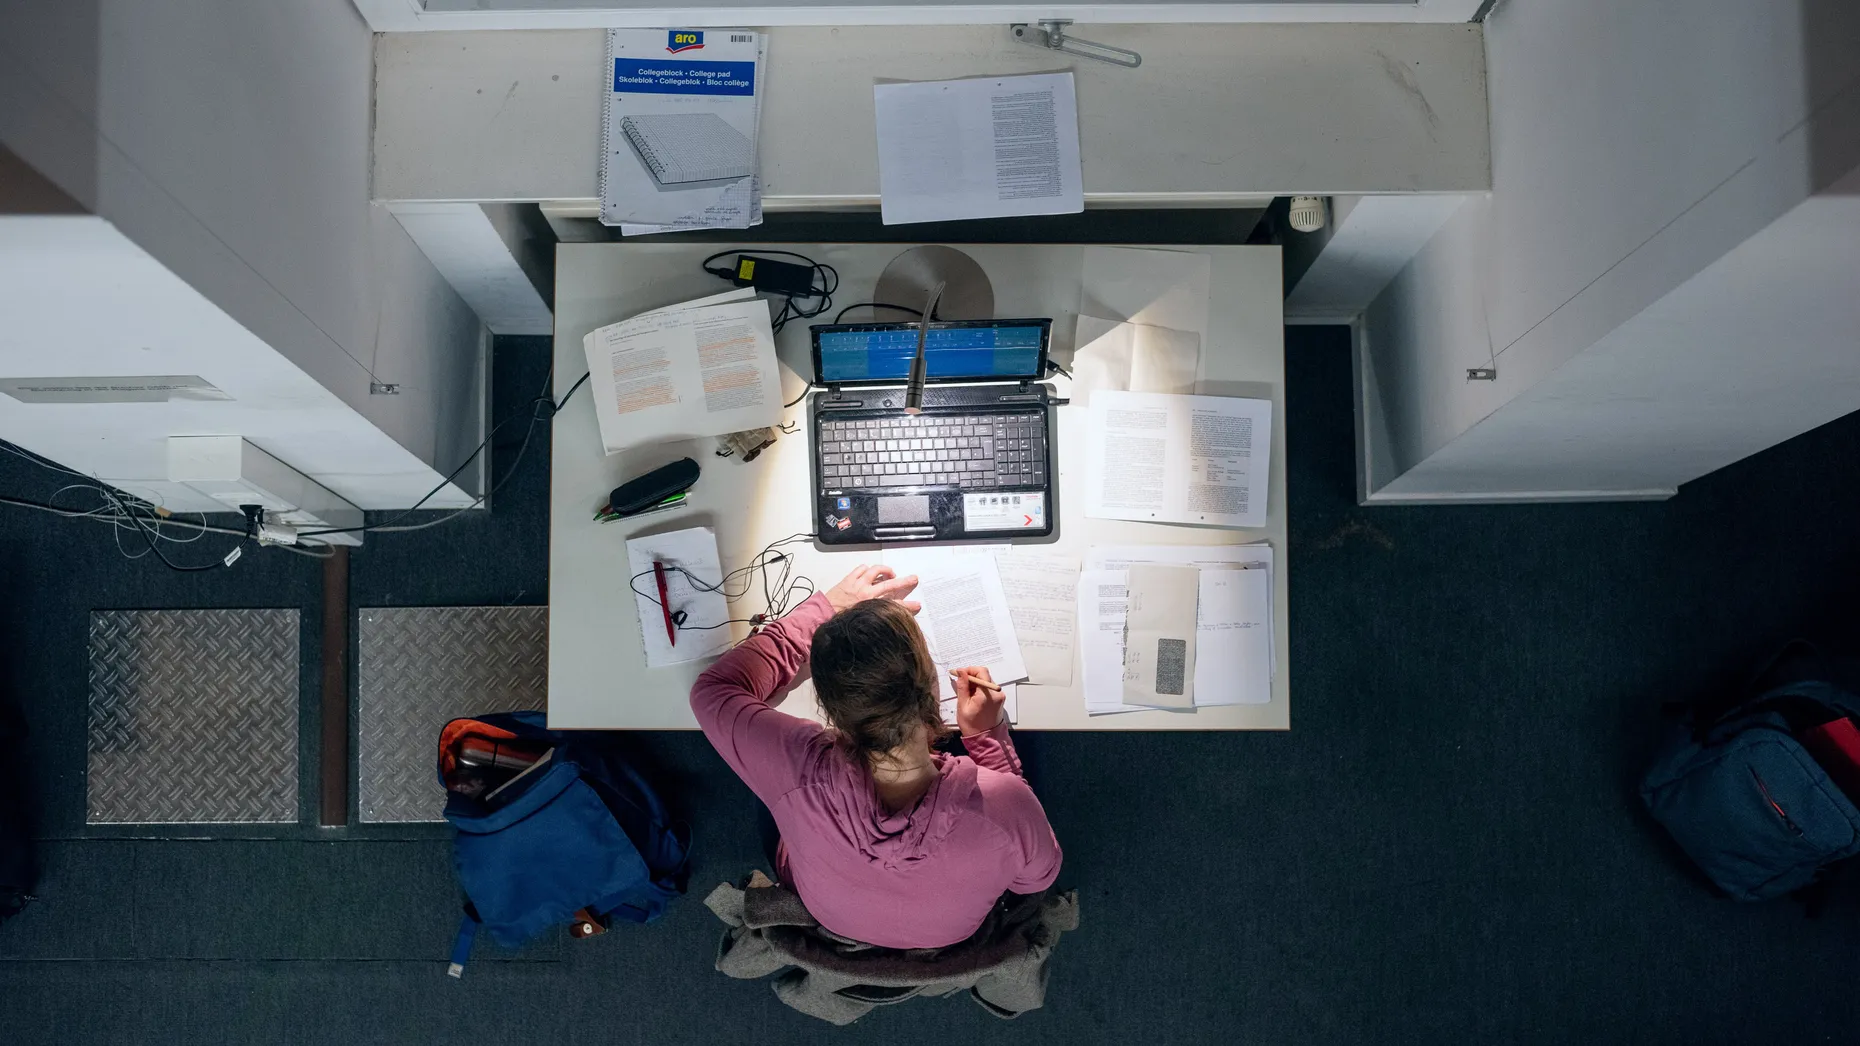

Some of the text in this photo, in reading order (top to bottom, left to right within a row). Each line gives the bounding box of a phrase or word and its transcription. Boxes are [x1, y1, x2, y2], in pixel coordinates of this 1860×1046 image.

[675, 33, 697, 44] aro
[638, 68, 730, 79] Collegeblock College pad
[619, 76, 653, 84] Skoleblok
[659, 77, 701, 86] Collegeblok
[723, 79, 750, 88] collège
